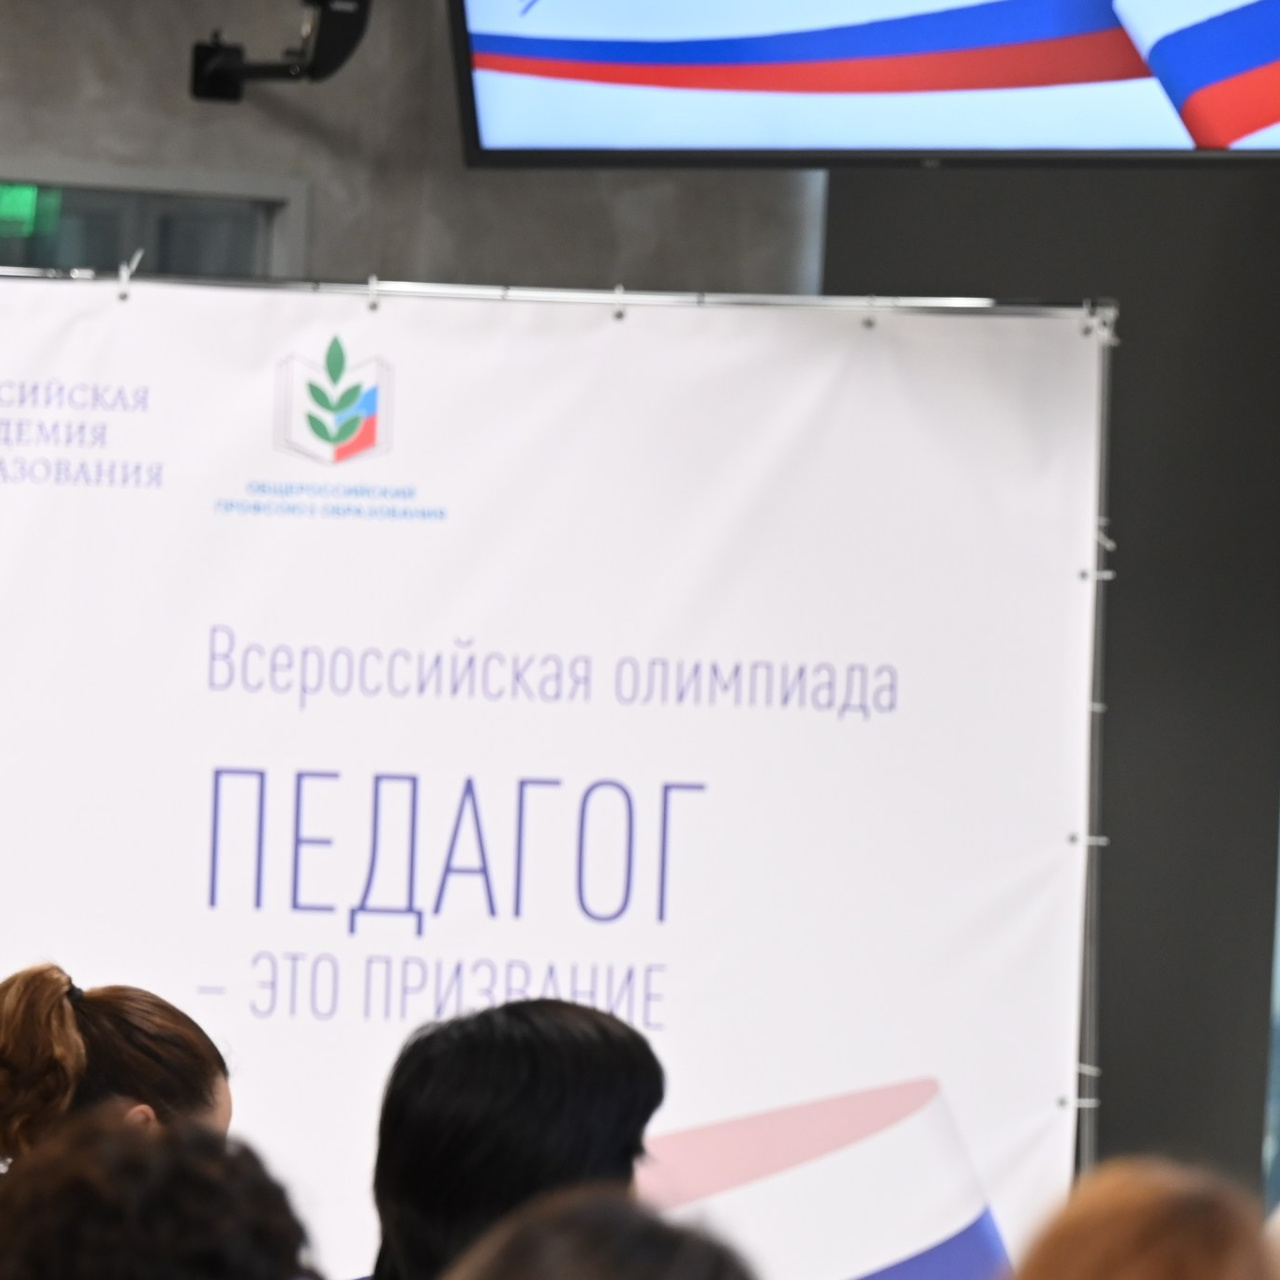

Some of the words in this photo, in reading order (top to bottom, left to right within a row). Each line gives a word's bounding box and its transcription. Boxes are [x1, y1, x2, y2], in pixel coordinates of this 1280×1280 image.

[206, 624, 593, 710] Всероссийская
[614, 656, 898, 720] олимпиада
[208, 767, 706, 937] ПЕДАГОГ
[249, 950, 340, 1021] ЭТО
